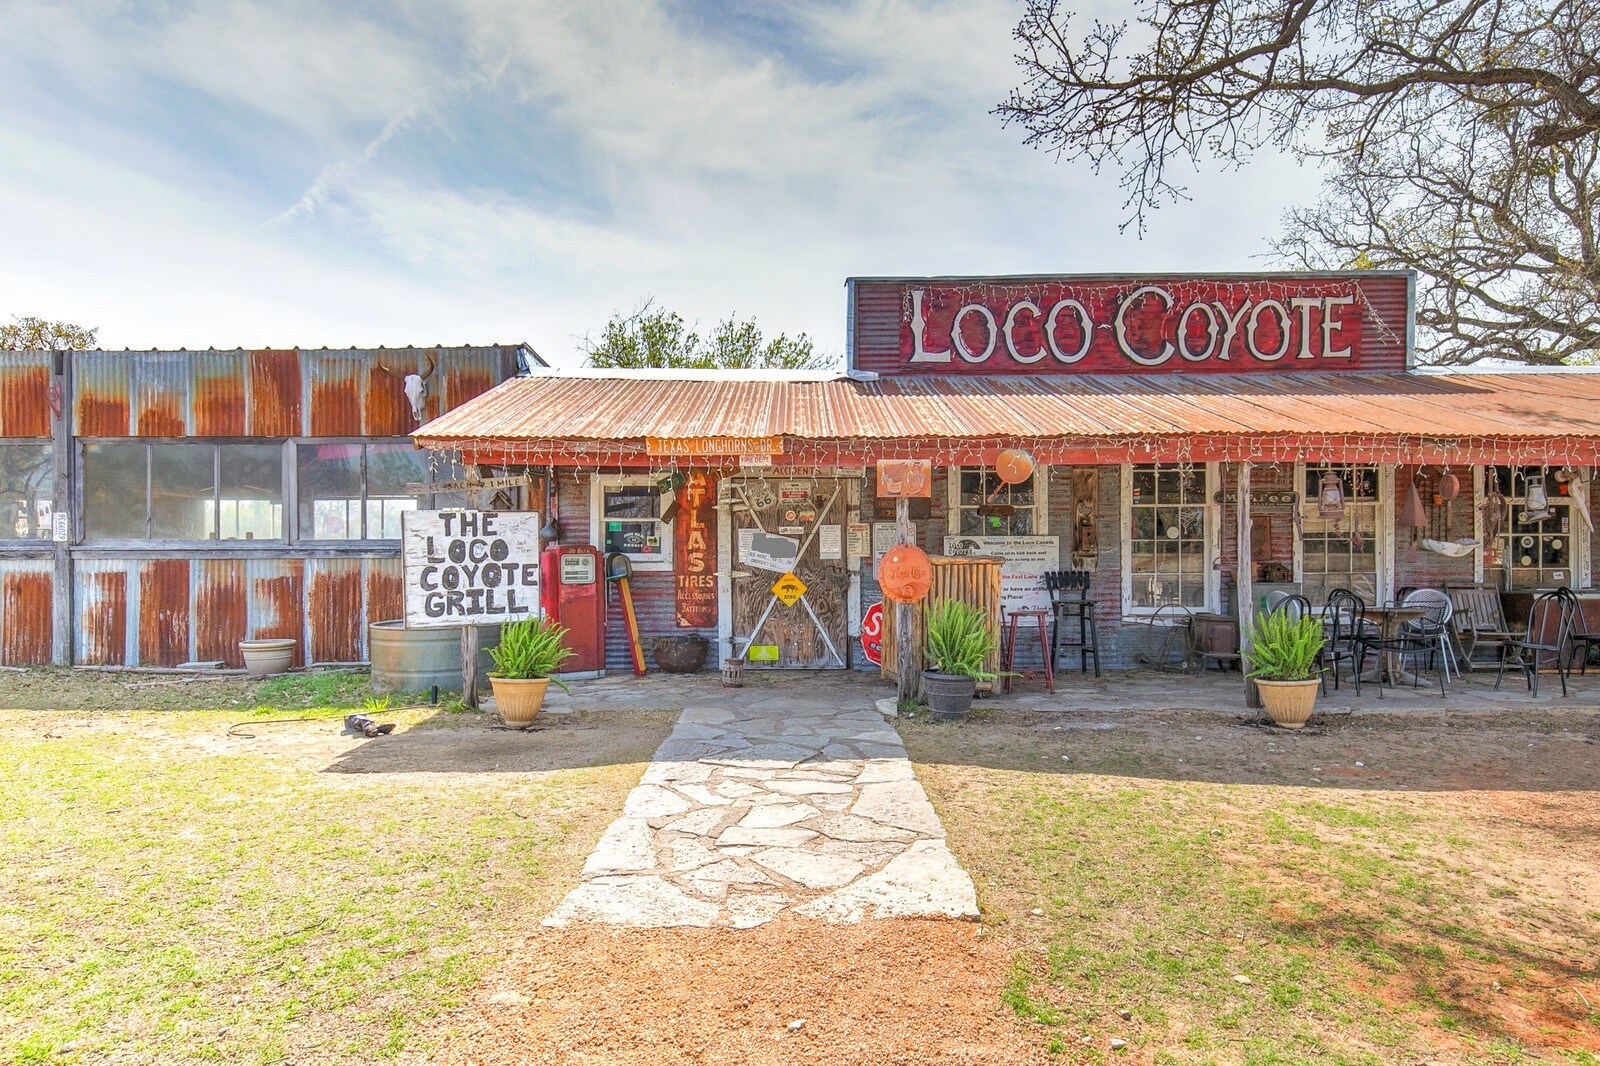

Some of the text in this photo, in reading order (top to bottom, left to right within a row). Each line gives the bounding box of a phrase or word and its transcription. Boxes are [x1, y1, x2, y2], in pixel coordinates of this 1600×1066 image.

[909, 286, 1353, 366] LOCO COYOTE
[657, 439, 777, 453] TEXAS LONGHORNS DR.
[497, 478, 520, 487] MILE
[756, 494, 772, 508] 66
[439, 512, 498, 537] THE
[686, 472, 706, 573] ATLAS
[426, 536, 509, 564] LOCO
[420, 562, 538, 591] COYOTE
[678, 575, 714, 588] TIRES
[425, 588, 530, 618] GRILL
